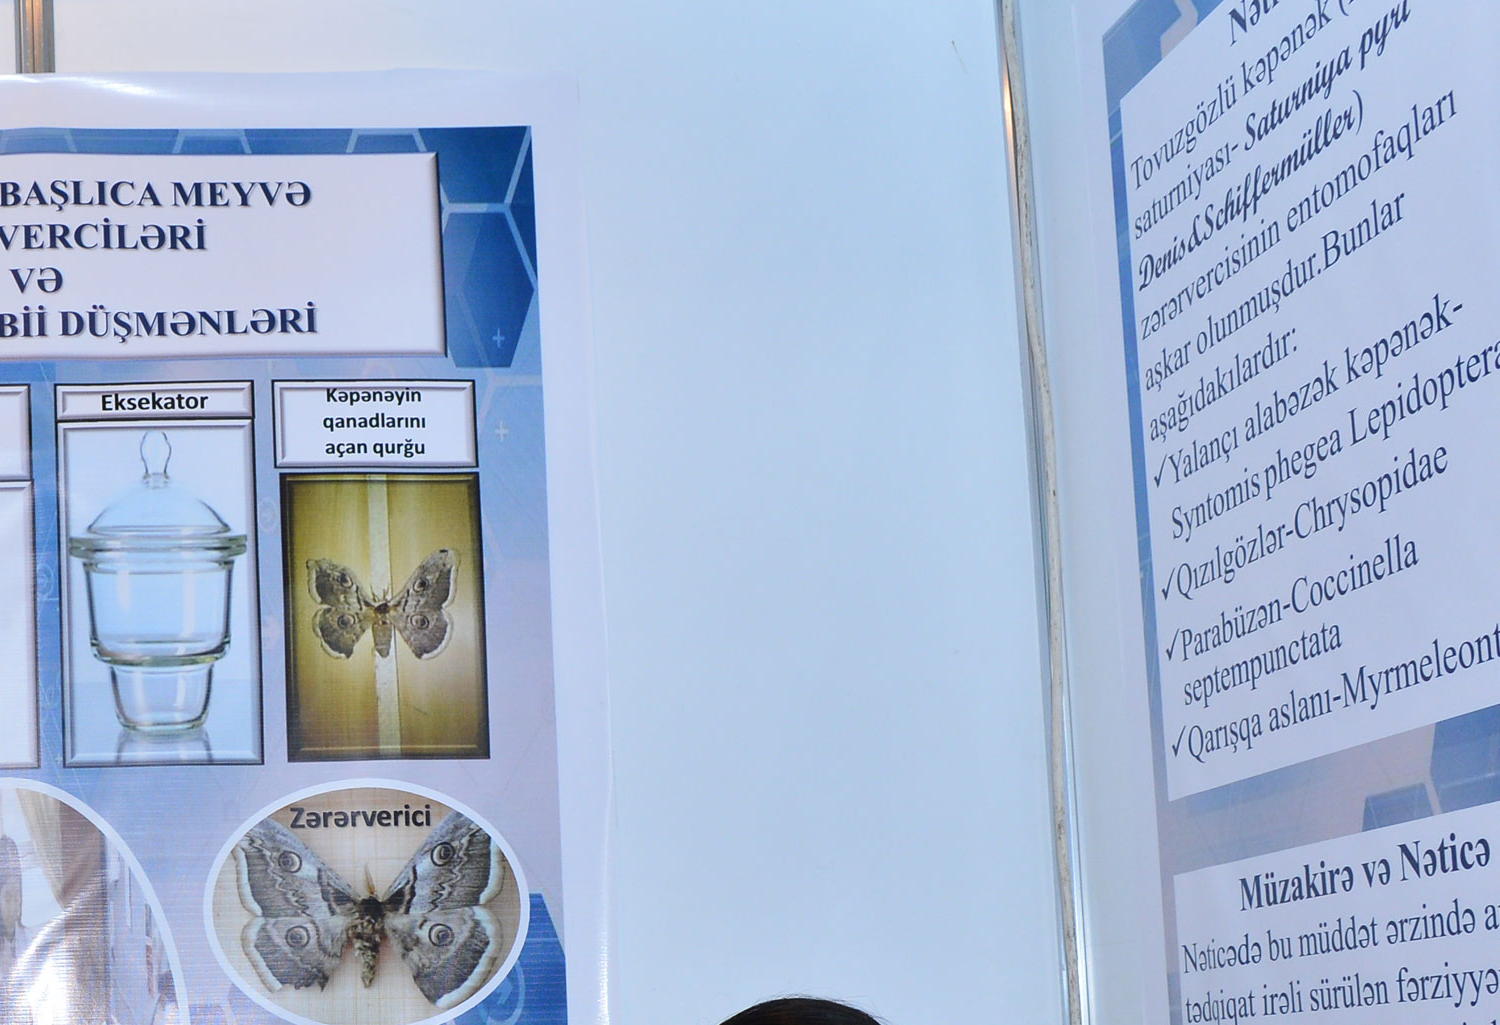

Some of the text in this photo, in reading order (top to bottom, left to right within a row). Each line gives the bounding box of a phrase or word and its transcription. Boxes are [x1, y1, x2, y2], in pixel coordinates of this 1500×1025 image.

[1131, 0, 1332, 190] Tovuzgözlü kəpənək
[1135, 45, 1353, 240] saturniyası- Saturniya
[170, 181, 312, 208] MEYVƏ
[1141, 90, 1457, 340] zərərvercisinin entomofaqları
[9, 267, 63, 294] VƏ
[58, 301, 318, 344] DÜŞMƏNLƏRİ
[326, 388, 422, 406] Kəpənəyin
[1146, 341, 1191, 392] aşkar
[1150, 328, 1297, 443] aşağıdakılardır:
[1168, 293, 1463, 484] Yalançı alabəzək kəpənək-
[101, 394, 208, 411] Eksekator
[323, 412, 425, 432] qanadlarını
[325, 438, 425, 458] açan qurğu
[1172, 430, 1343, 543] Syntomis phegea
[1177, 447, 1448, 600] Qızılgözlər-Chrysopidae
[1181, 534, 1419, 661] Parabüzən-Coccinella
[1184, 623, 1342, 708] septempunctata
[1188, 714, 1263, 763] Qarışqa
[290, 804, 431, 828] Zərərverici
[1239, 833, 1490, 911] Müzakirə və Nəticə
[1182, 898, 1475, 973] Nəticədə bu müddət ərzində
[1262, 980, 1304, 1016] irəli
[1310, 973, 1390, 1011] sürülən
